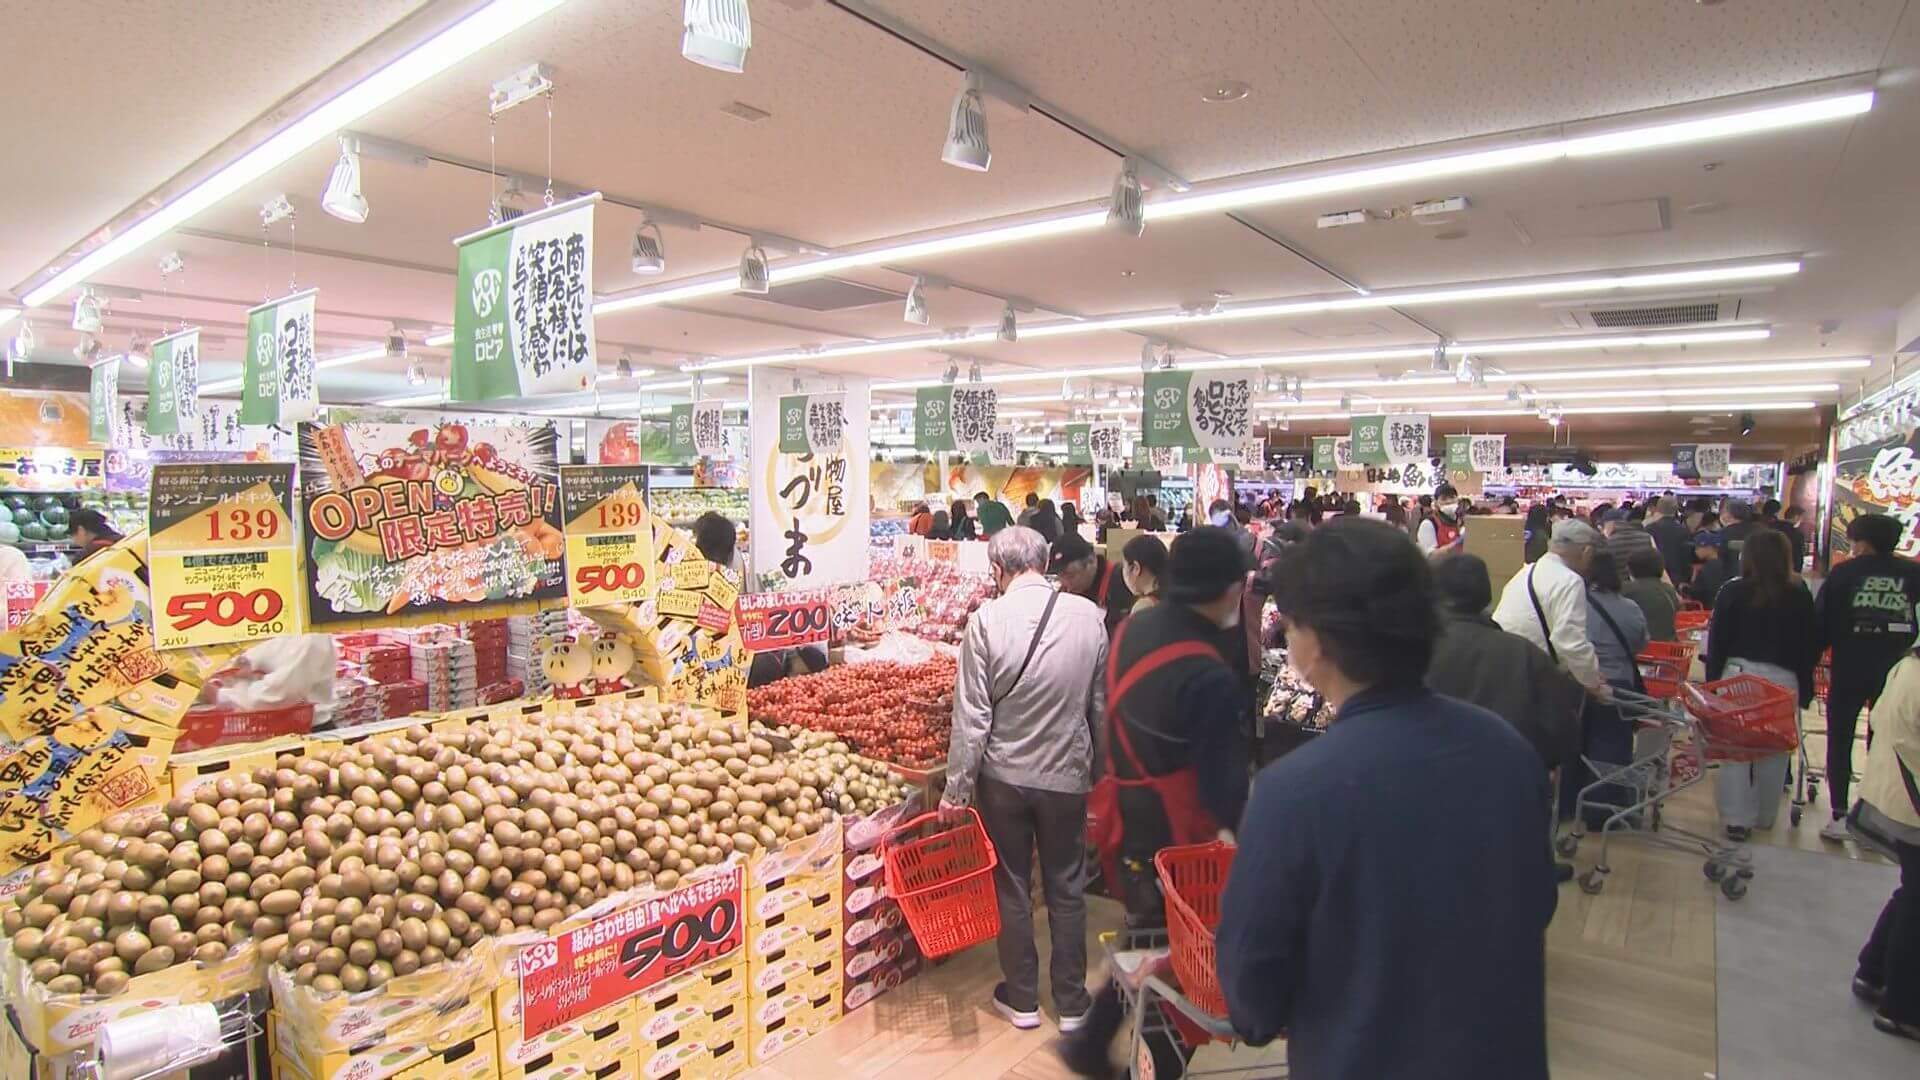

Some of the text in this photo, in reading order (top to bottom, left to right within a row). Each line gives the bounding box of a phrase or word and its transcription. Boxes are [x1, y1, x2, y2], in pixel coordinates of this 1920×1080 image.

[566, 232, 588, 363] 商売とは
[475, 340, 503, 362] ロピア
[258, 382, 276, 398] ロピア
[924, 427, 946, 437] ロピア
[1153, 419, 1181, 430] ロピア
[156, 490, 286, 507] サンゴールドキウイ
[825, 453, 848, 516] 物屋
[206, 508, 279, 541] 139
[309, 480, 435, 541] OPEN
[379, 483, 558, 563] 限定特売!!
[597, 502, 641, 529] 139
[575, 562, 646, 594] 500
[1863, 576, 1905, 592] BEN
[166, 588, 284, 631] 500
[622, 589, 646, 600] 540
[246, 621, 284, 636] 540
[767, 606, 830, 638] 200
[620, 899, 737, 980] 500
[664, 938, 736, 977] 540
